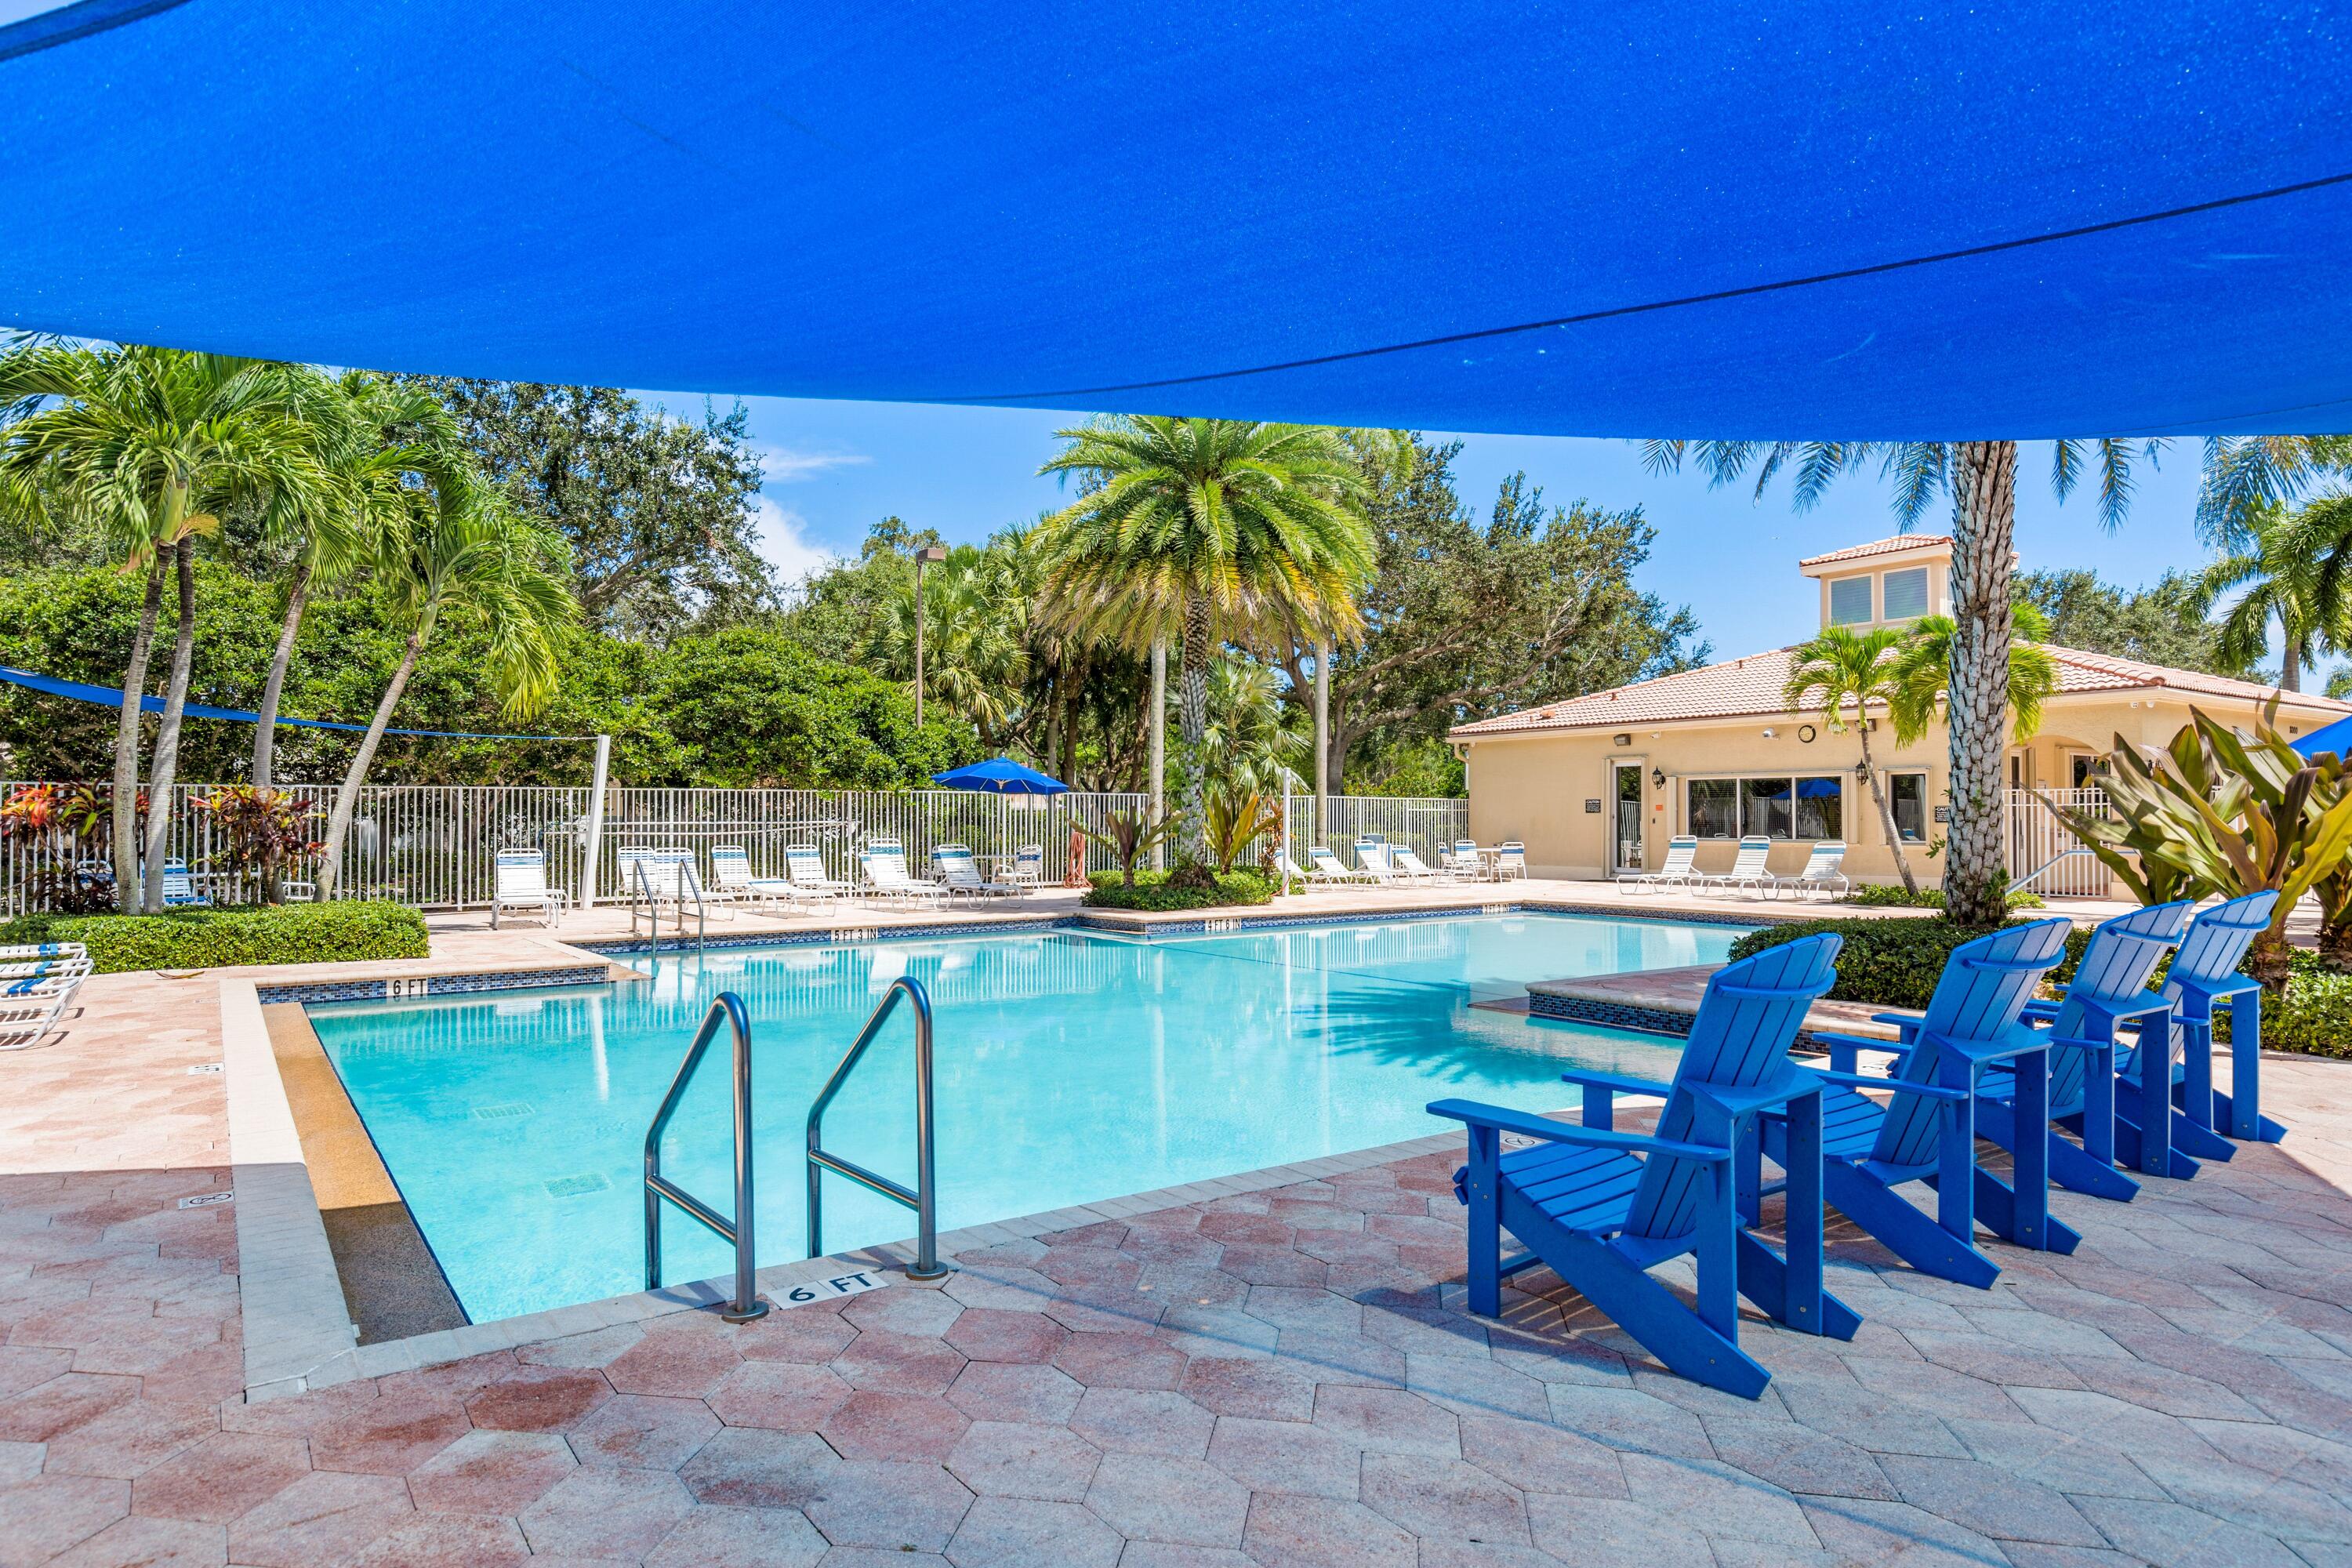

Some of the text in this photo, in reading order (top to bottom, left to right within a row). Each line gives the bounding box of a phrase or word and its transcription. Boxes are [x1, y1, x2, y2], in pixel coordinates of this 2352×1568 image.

[1214, 919, 1223, 931] FT
[1232, 918, 1240, 931] IN
[834, 927, 877, 941] 5 FT 3 IN
[393, 978, 426, 995] 6 FT
[789, 1272, 873, 1301] 6 FT
